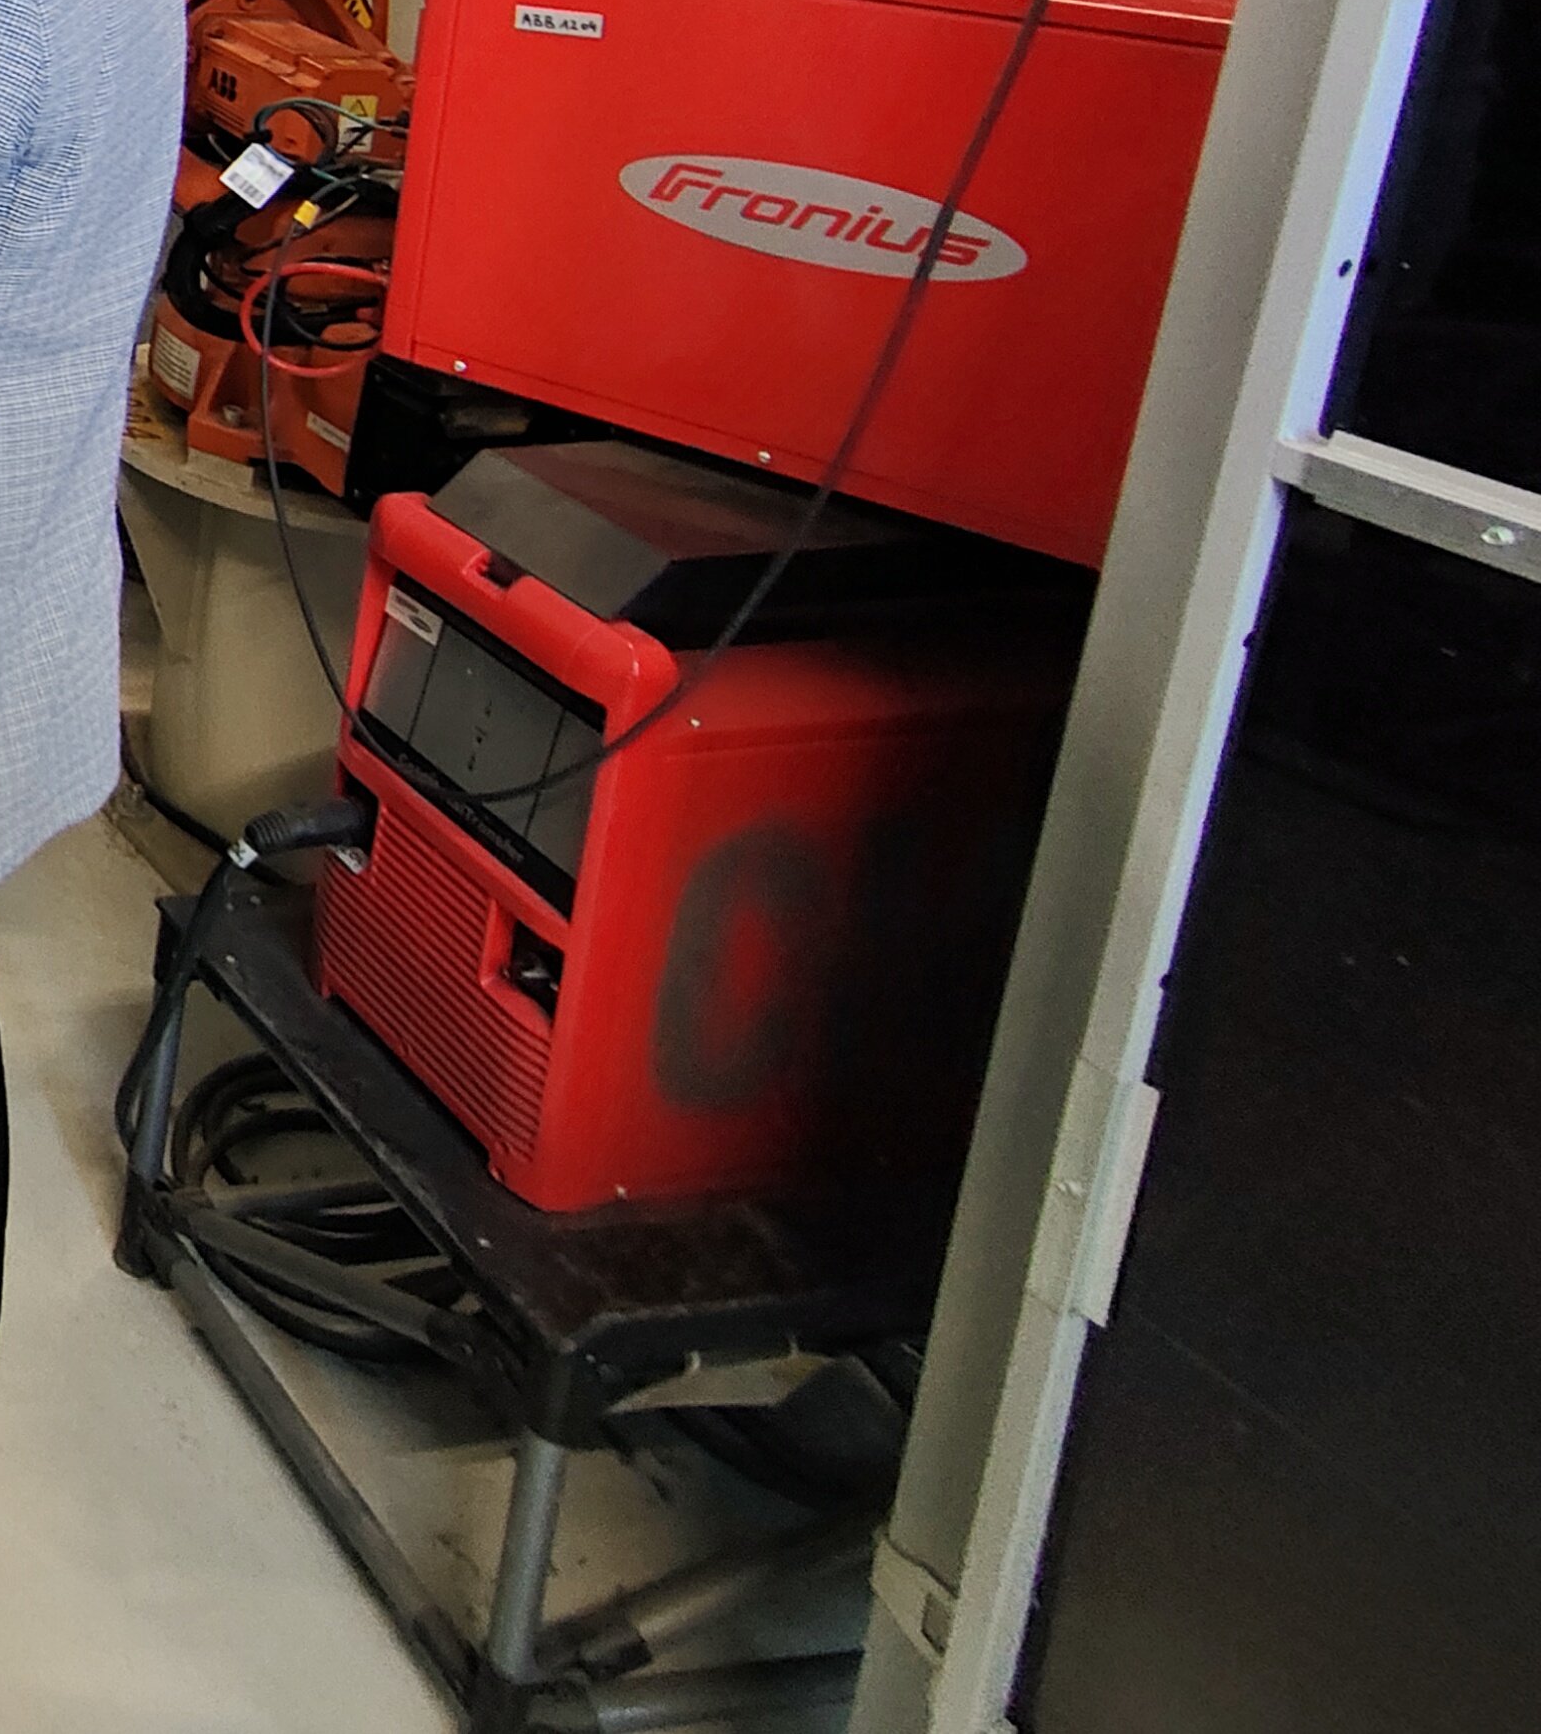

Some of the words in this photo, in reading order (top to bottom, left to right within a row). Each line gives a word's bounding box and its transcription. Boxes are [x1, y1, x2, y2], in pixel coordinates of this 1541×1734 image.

[522, 13, 556, 29] ABB
[208, 68, 237, 102] ABB
[648, 163, 991, 266] Fronius
